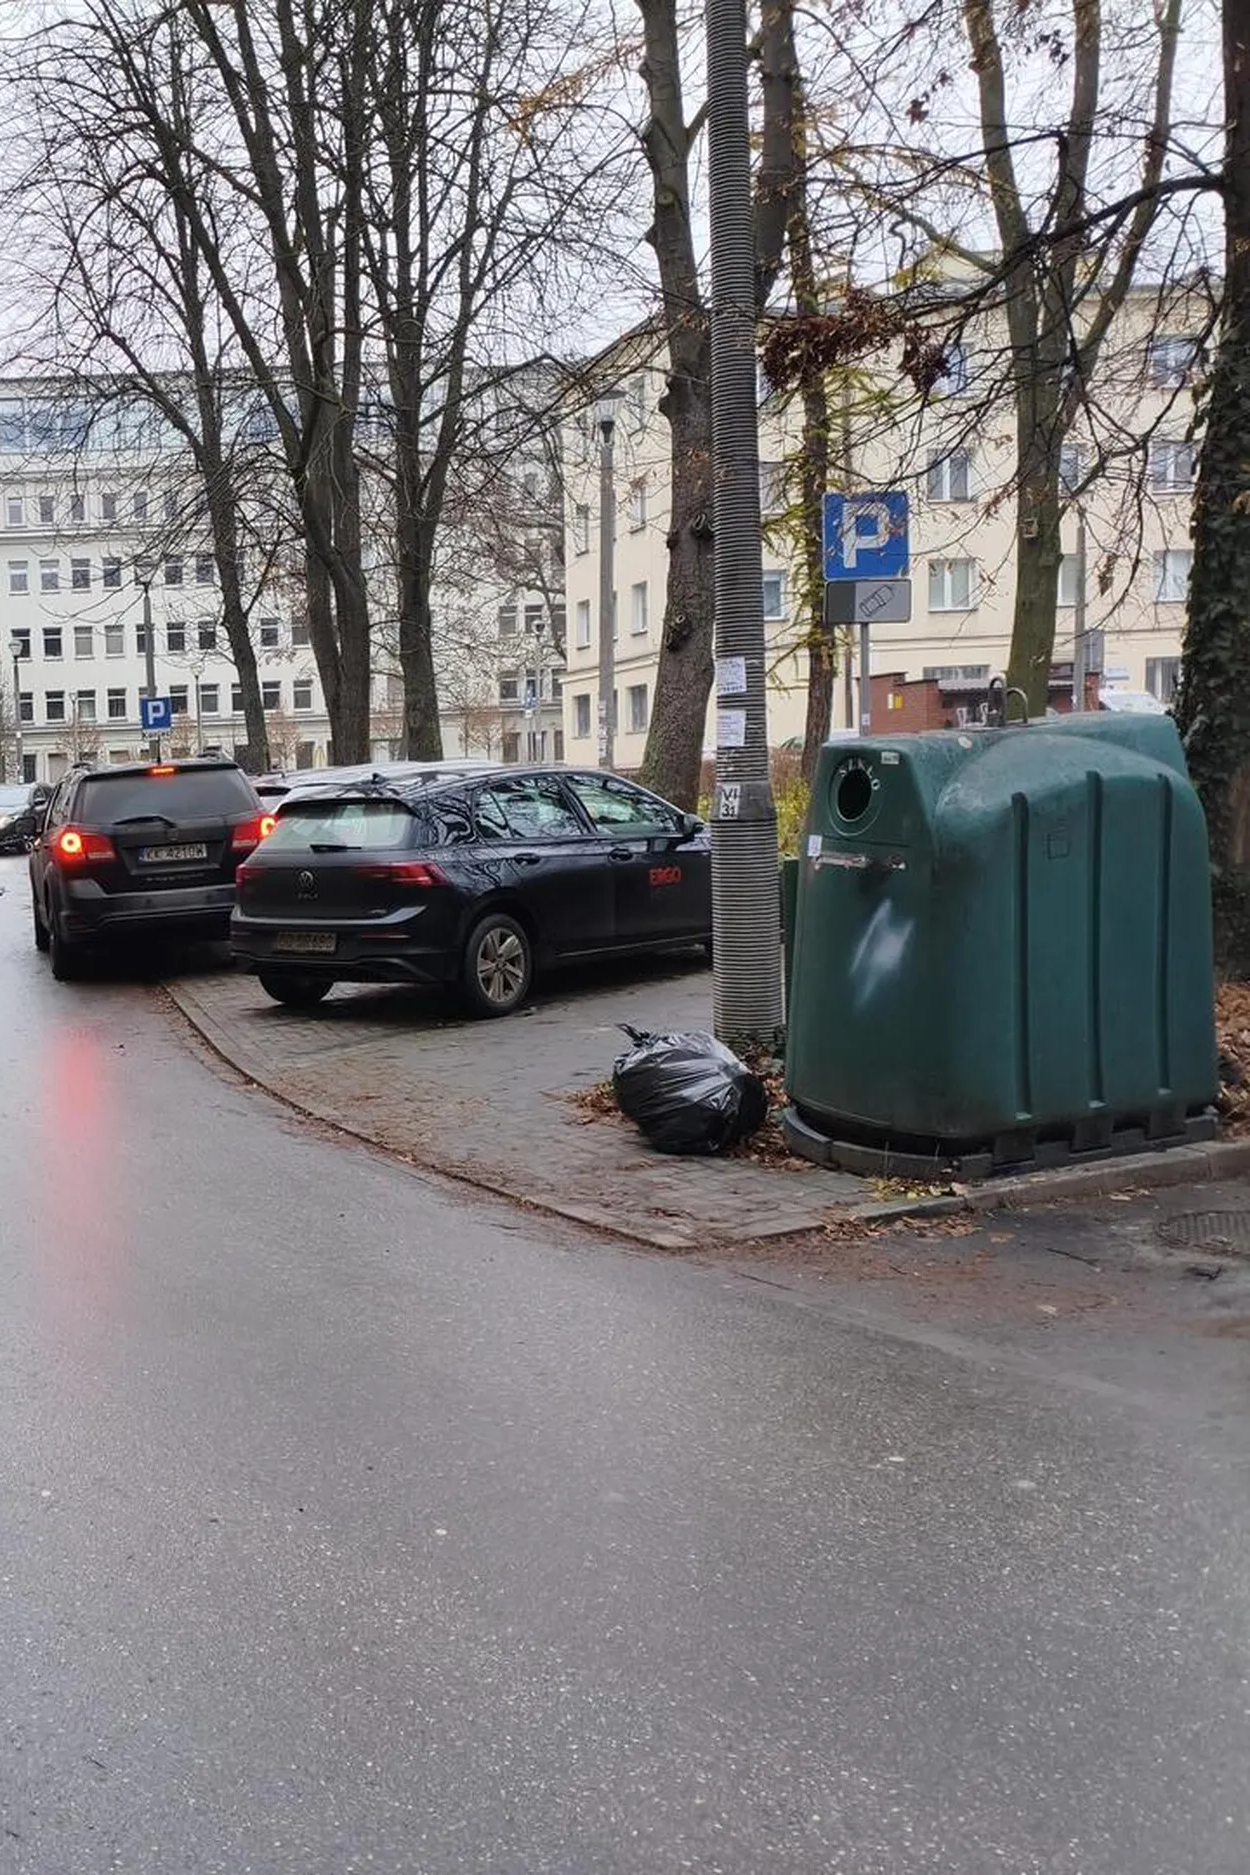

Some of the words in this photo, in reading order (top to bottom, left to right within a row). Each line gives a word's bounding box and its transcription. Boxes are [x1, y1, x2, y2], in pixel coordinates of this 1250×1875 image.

[841, 502, 891, 568] P
[147, 701, 165, 724] P
[722, 802, 737, 818] 31
[650, 867, 681, 885] ERGO
